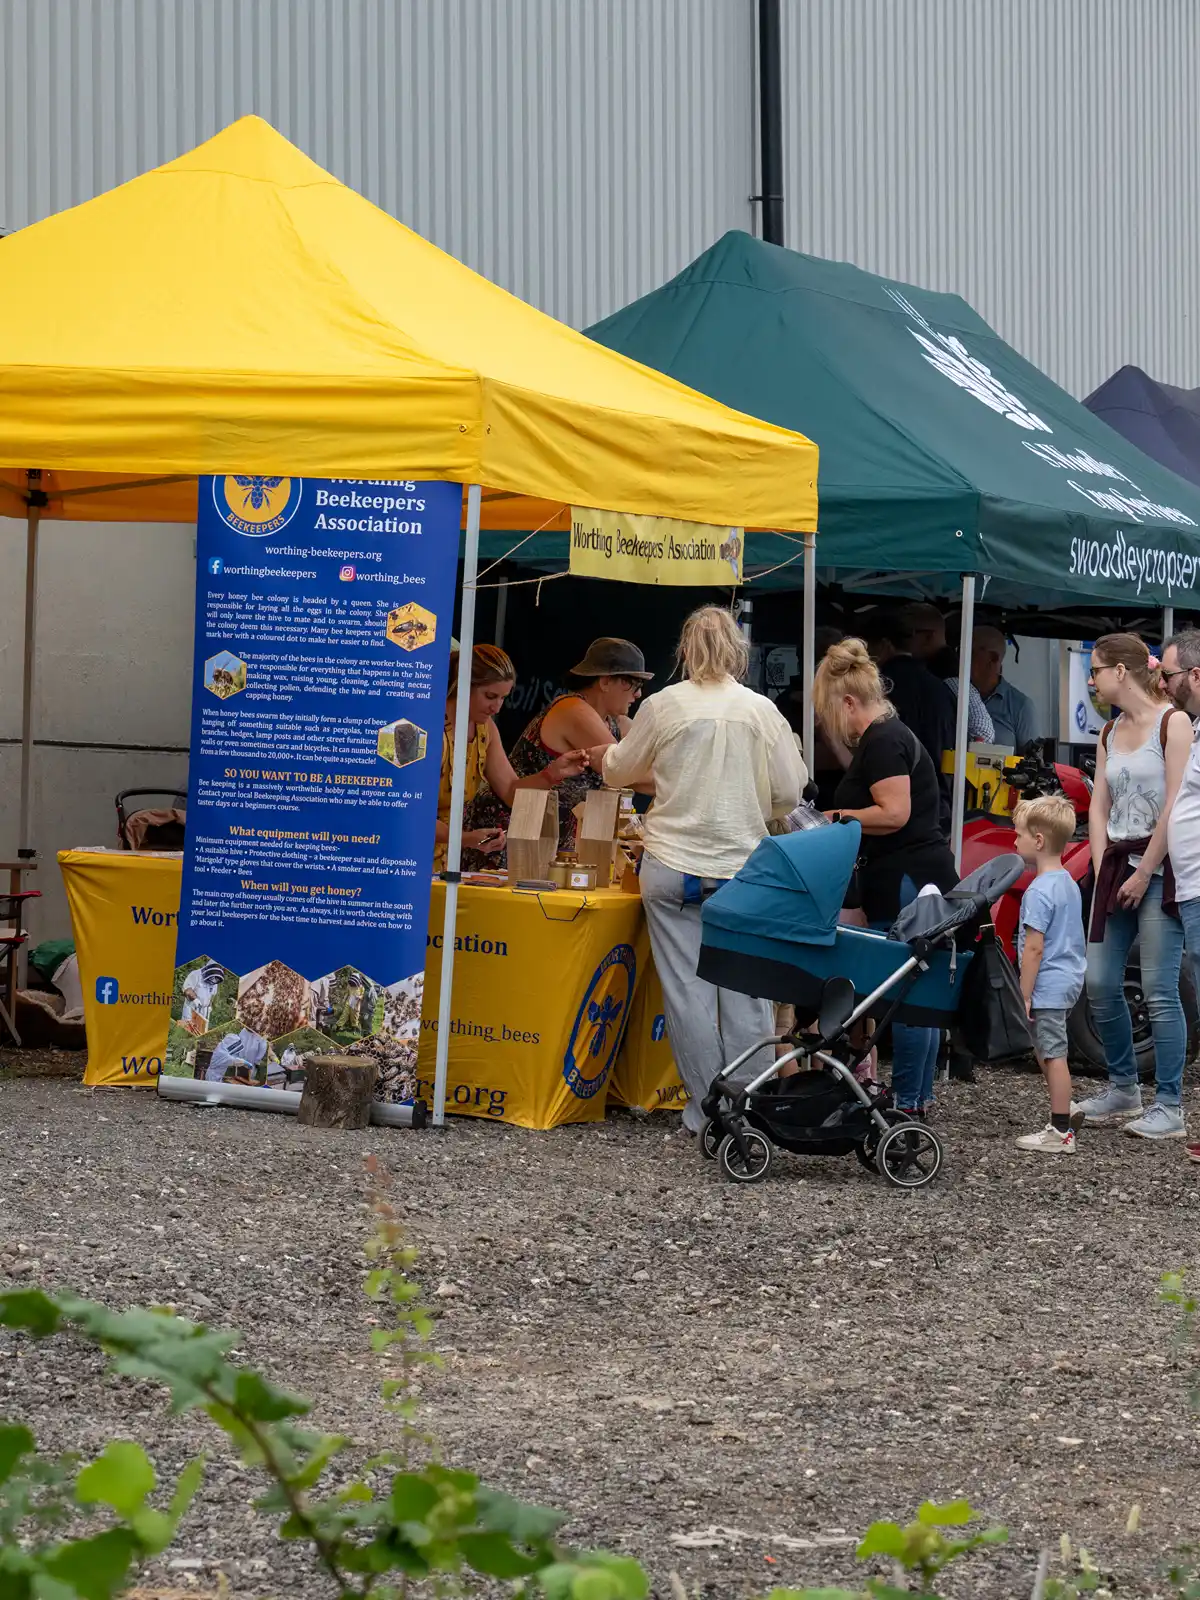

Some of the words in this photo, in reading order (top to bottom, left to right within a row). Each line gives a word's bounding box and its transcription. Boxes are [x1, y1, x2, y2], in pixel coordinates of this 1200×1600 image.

[316, 489, 426, 514] Beekeepers
[226, 513, 285, 533] BEEKEEPERS
[314, 513, 422, 534] Association
[264, 544, 382, 562] worthing-beekeepers.org
[223, 564, 316, 580] worthingbeekeepers
[355, 571, 426, 586] worthing_bees
[207, 590, 224, 600] Every
[227, 591, 248, 602] honey
[251, 592, 264, 600] bee
[266, 593, 289, 604] colony
[302, 595, 327, 604] headed
[330, 597, 339, 606] by
[376, 599, 389, 607] She
[392, 600, 398, 608] is
[237, 650, 251, 658] The
[251, 651, 279, 662] majority
[280, 653, 288, 661] of
[288, 653, 299, 661] the
[299, 654, 316, 662] bees
[316, 655, 323, 663] in
[324, 655, 335, 663] the
[335, 656, 358, 666] colony
[370, 658, 395, 666] worker
[414, 660, 433, 671] They
[259, 661, 297, 673] responsible
[298, 664, 309, 672] for
[309, 664, 346, 676] everything
[346, 666, 361, 674] that
[362, 667, 391, 678] happens
[391, 669, 399, 677] in
[400, 669, 413, 677] the
[245, 671, 271, 681] making
[290, 673, 313, 684] raising
[372, 678, 404, 689] collecting
[245, 680, 277, 691] collecting
[303, 684, 336, 695] defending
[351, 686, 366, 694] hive
[367, 687, 380, 695] and
[385, 688, 415, 699] creating
[415, 690, 430, 698] and
[245, 691, 271, 701] capping
[201, 717, 225, 728] hanging
[226, 718, 236, 726] off
[238, 719, 273, 730] something
[275, 721, 302, 730] suitable
[303, 723, 319, 731] such
[364, 727, 378, 735] tree
[223, 767, 237, 777] SO
[239, 768, 259, 779] YOU
[261, 770, 292, 781] WANT
[292, 772, 308, 782] TO
[309, 773, 323, 782] BE
[324, 773, 332, 783] A
[333, 774, 393, 786] BEEKEEPER
[197, 787, 220, 796] Contact
[220, 791, 236, 799] your
[237, 790, 252, 798] local
[253, 791, 290, 802] Beekeeping
[290, 793, 328, 802] Association
[328, 795, 343, 803] who
[343, 798, 358, 806] may
[358, 797, 367, 805] be
[367, 798, 382, 806] able
[382, 798, 390, 806] to
[390, 799, 408, 807] offer
[198, 778, 209, 786] Bee
[210, 779, 236, 789] keeping
[237, 780, 244, 788] is
[252, 781, 283, 792] massively
[285, 783, 323, 792] worthwhile
[324, 785, 345, 796] hobby
[346, 787, 359, 795] and
[360, 789, 385, 798] anyone
[401, 790, 412, 798] do
[197, 797, 214, 805] taster
[214, 798, 230, 808] days
[244, 800, 276, 811] beginners
[195, 835, 224, 844] Minimum
[224, 837, 259, 848] equipment
[259, 839, 283, 847] needed
[283, 840, 294, 848] for
[294, 841, 320, 852] keeping
[229, 824, 255, 836] What
[256, 826, 309, 842] equipment
[310, 830, 329, 841] will
[331, 834, 349, 845] you
[350, 832, 380, 844] need?
[240, 878, 268, 890] When
[270, 880, 289, 891] will
[290, 884, 308, 895] you
[309, 883, 325, 897] get
[326, 884, 362, 899] honey?
[190, 909, 205, 917] your
[205, 908, 221, 916] local
[221, 909, 258, 921] beekeepers
[269, 912, 280, 920] the
[280, 913, 294, 921] best
[295, 914, 310, 922] time
[310, 915, 317, 923] to
[318, 916, 342, 924] harvest
[342, 917, 355, 925] and
[355, 918, 377, 927] advice
[387, 920, 403, 929] how
